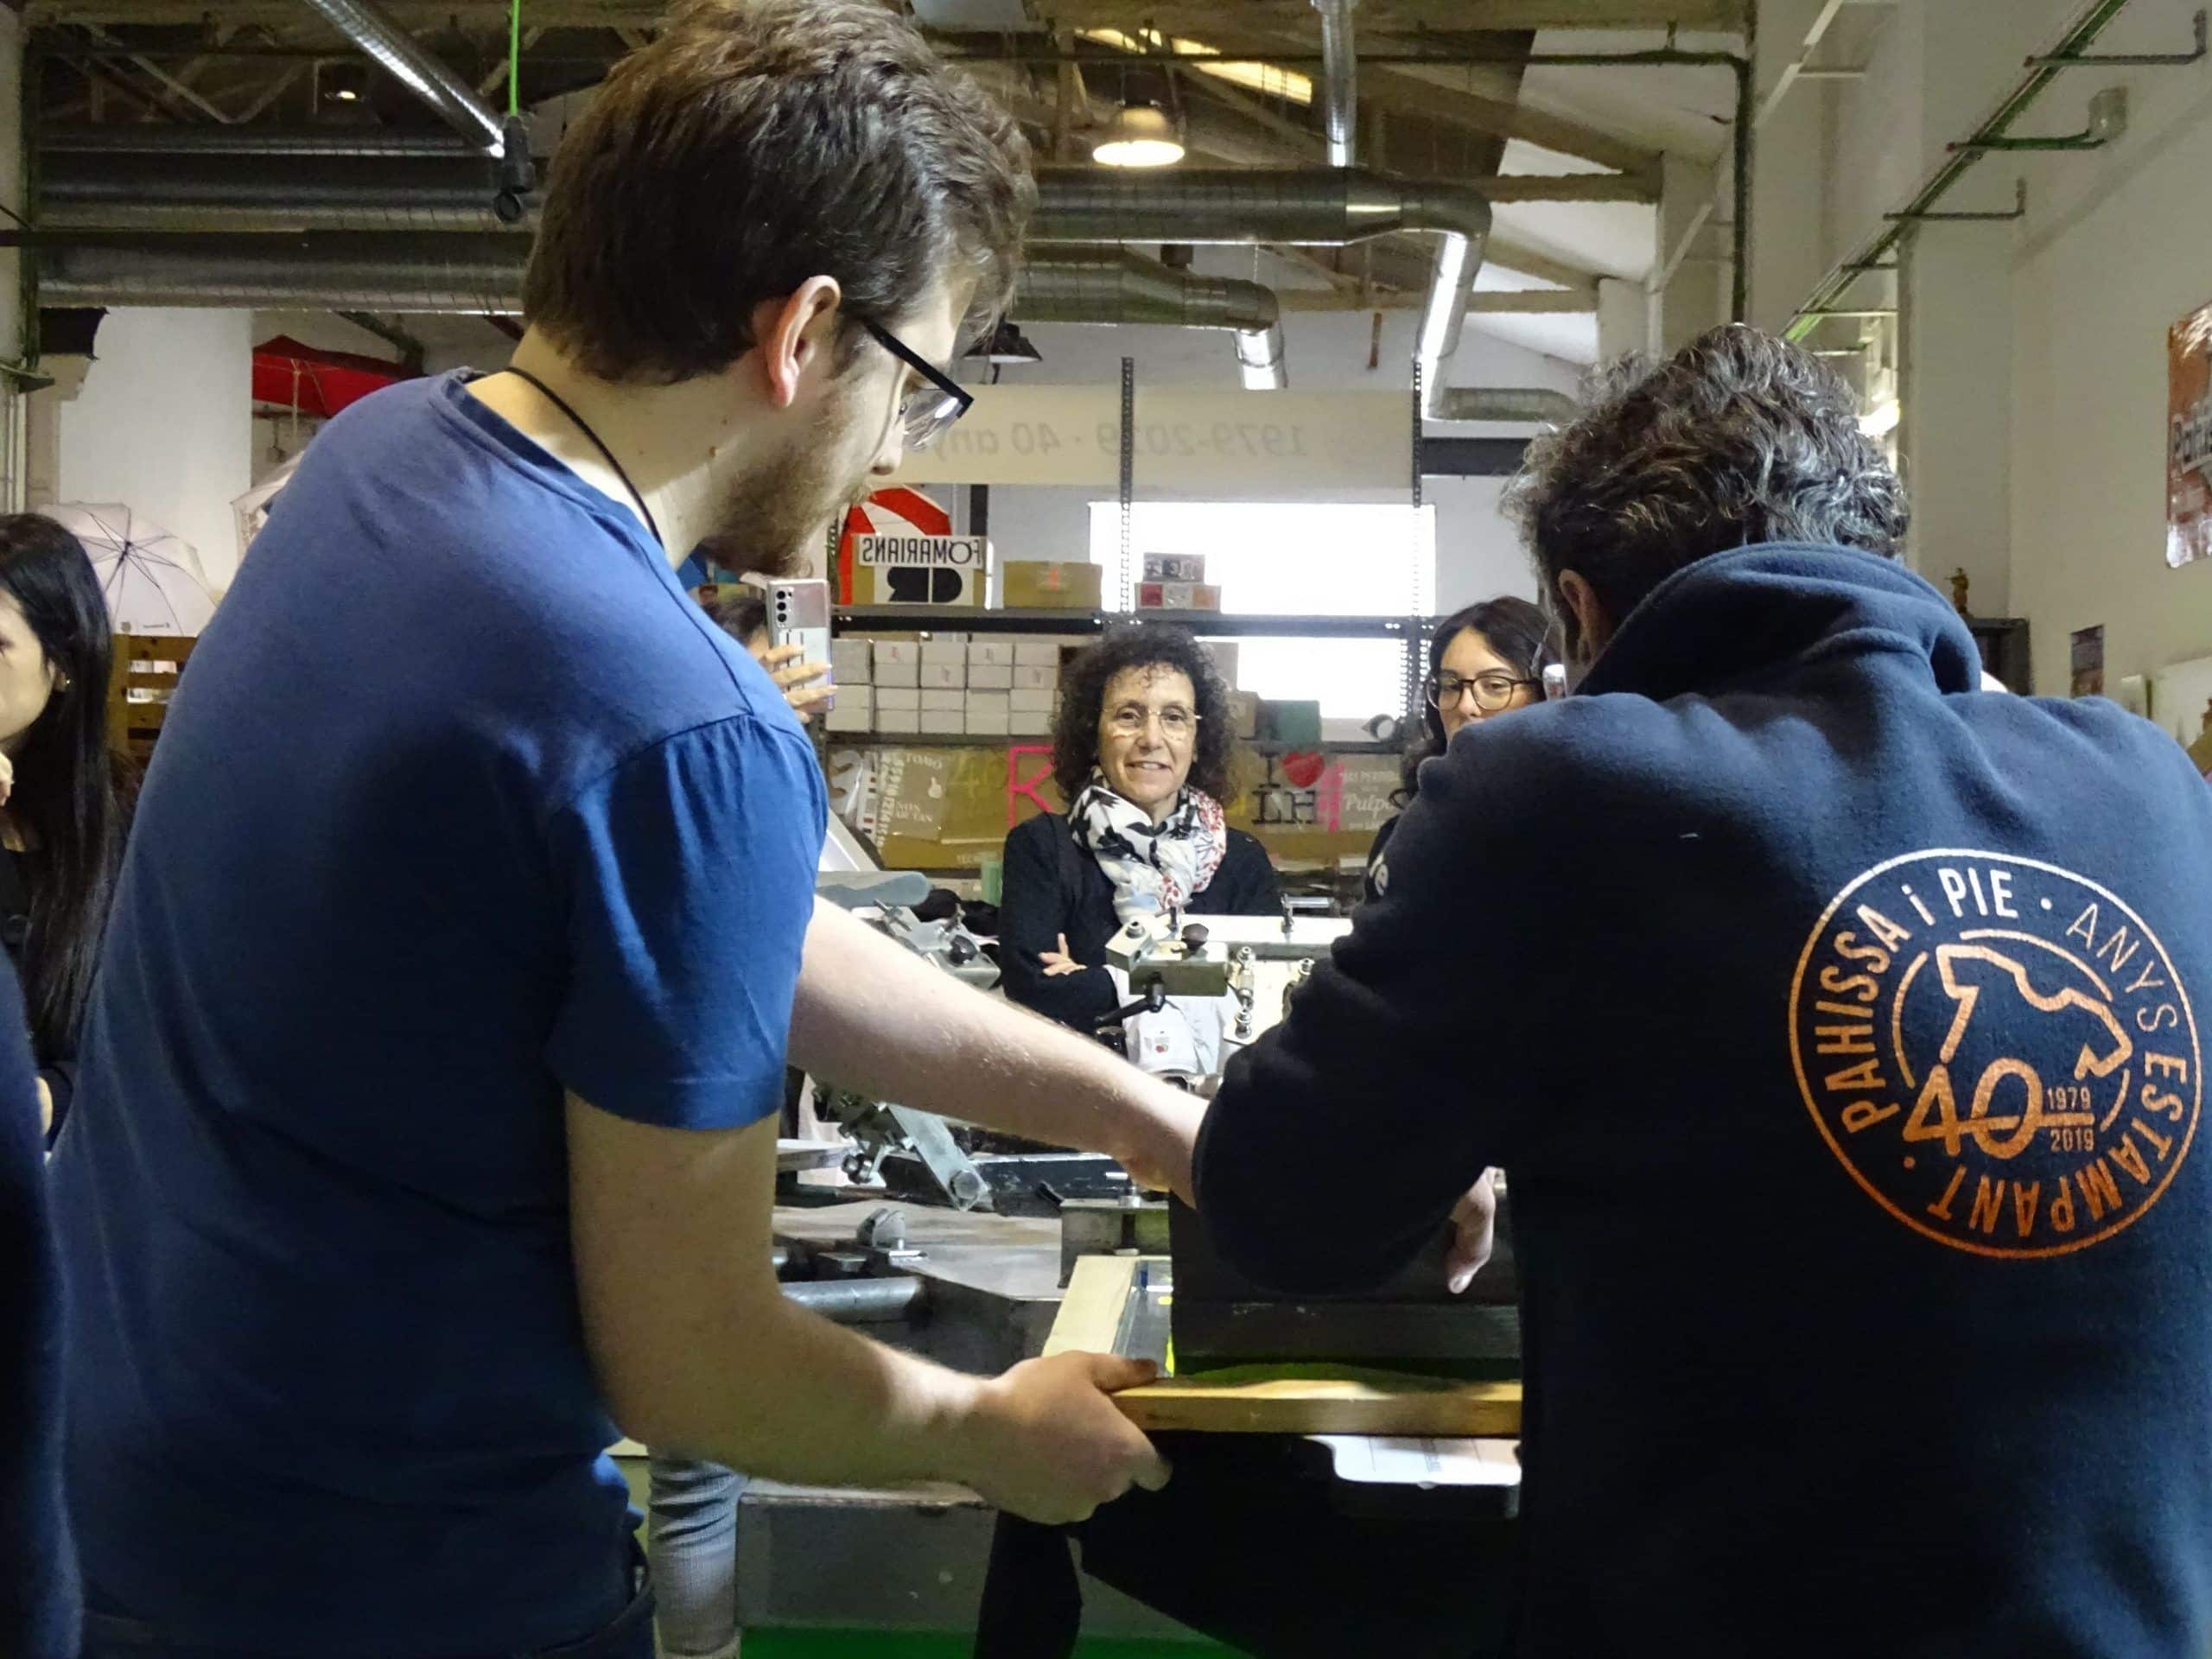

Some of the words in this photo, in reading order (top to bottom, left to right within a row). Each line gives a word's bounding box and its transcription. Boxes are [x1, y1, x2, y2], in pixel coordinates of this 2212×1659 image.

[1937, 868, 2018, 918] PIE
[1815, 904, 1912, 1133] PAHISSA
[2065, 902, 2179, 1033] ANYS
[1902, 1057, 2044, 1160] 40
[1927, 1051, 2188, 1237] ESTAMPANT
[2047, 1086, 2092, 1110] 1979
[2050, 1128, 2094, 1153] 2019
